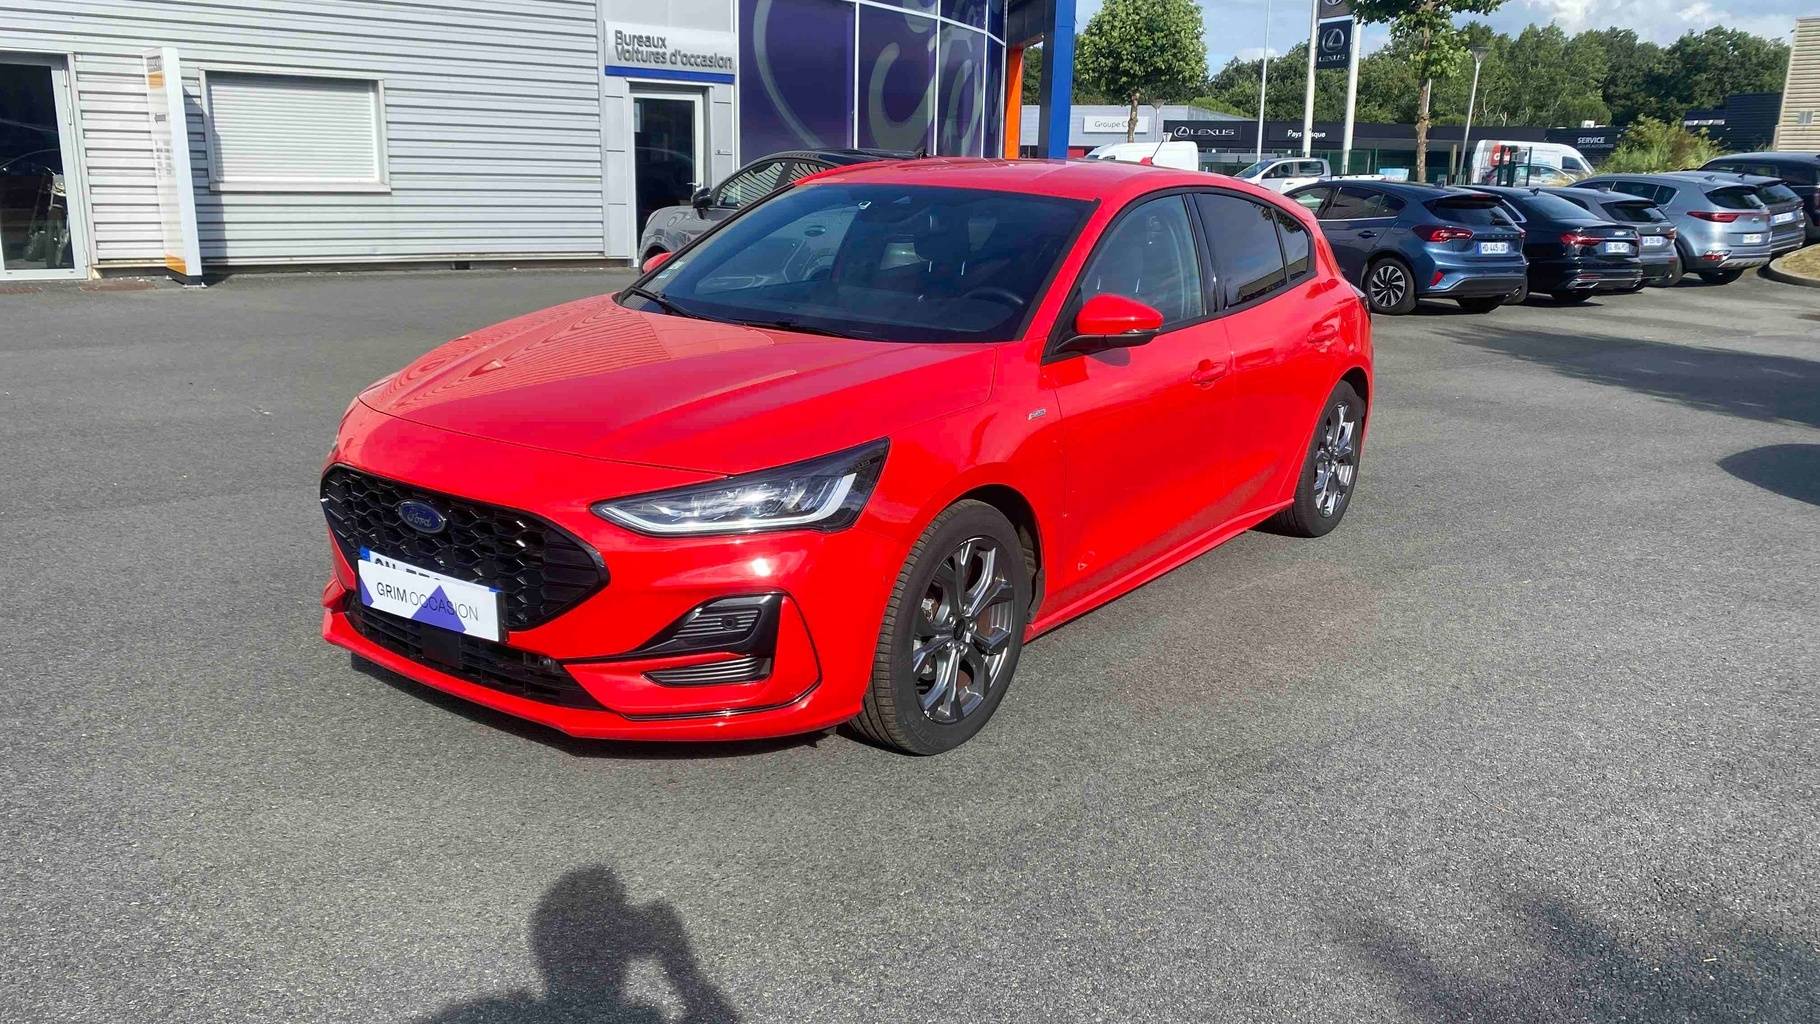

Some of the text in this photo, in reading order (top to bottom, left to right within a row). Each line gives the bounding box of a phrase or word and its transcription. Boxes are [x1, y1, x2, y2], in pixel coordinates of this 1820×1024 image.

[614, 29, 667, 49] Bureaux
[615, 46, 733, 70] Voitures d'occasion
[1318, 54, 1346, 62] LEXUS
[1094, 120, 1121, 129] Groupe
[1190, 128, 1235, 136] LEXUS
[1287, 129, 1326, 139] Pays sque
[1577, 136, 1606, 144] SERVICE
[407, 511, 433, 528] Ford
[376, 581, 479, 622] GRIM OCCASION
